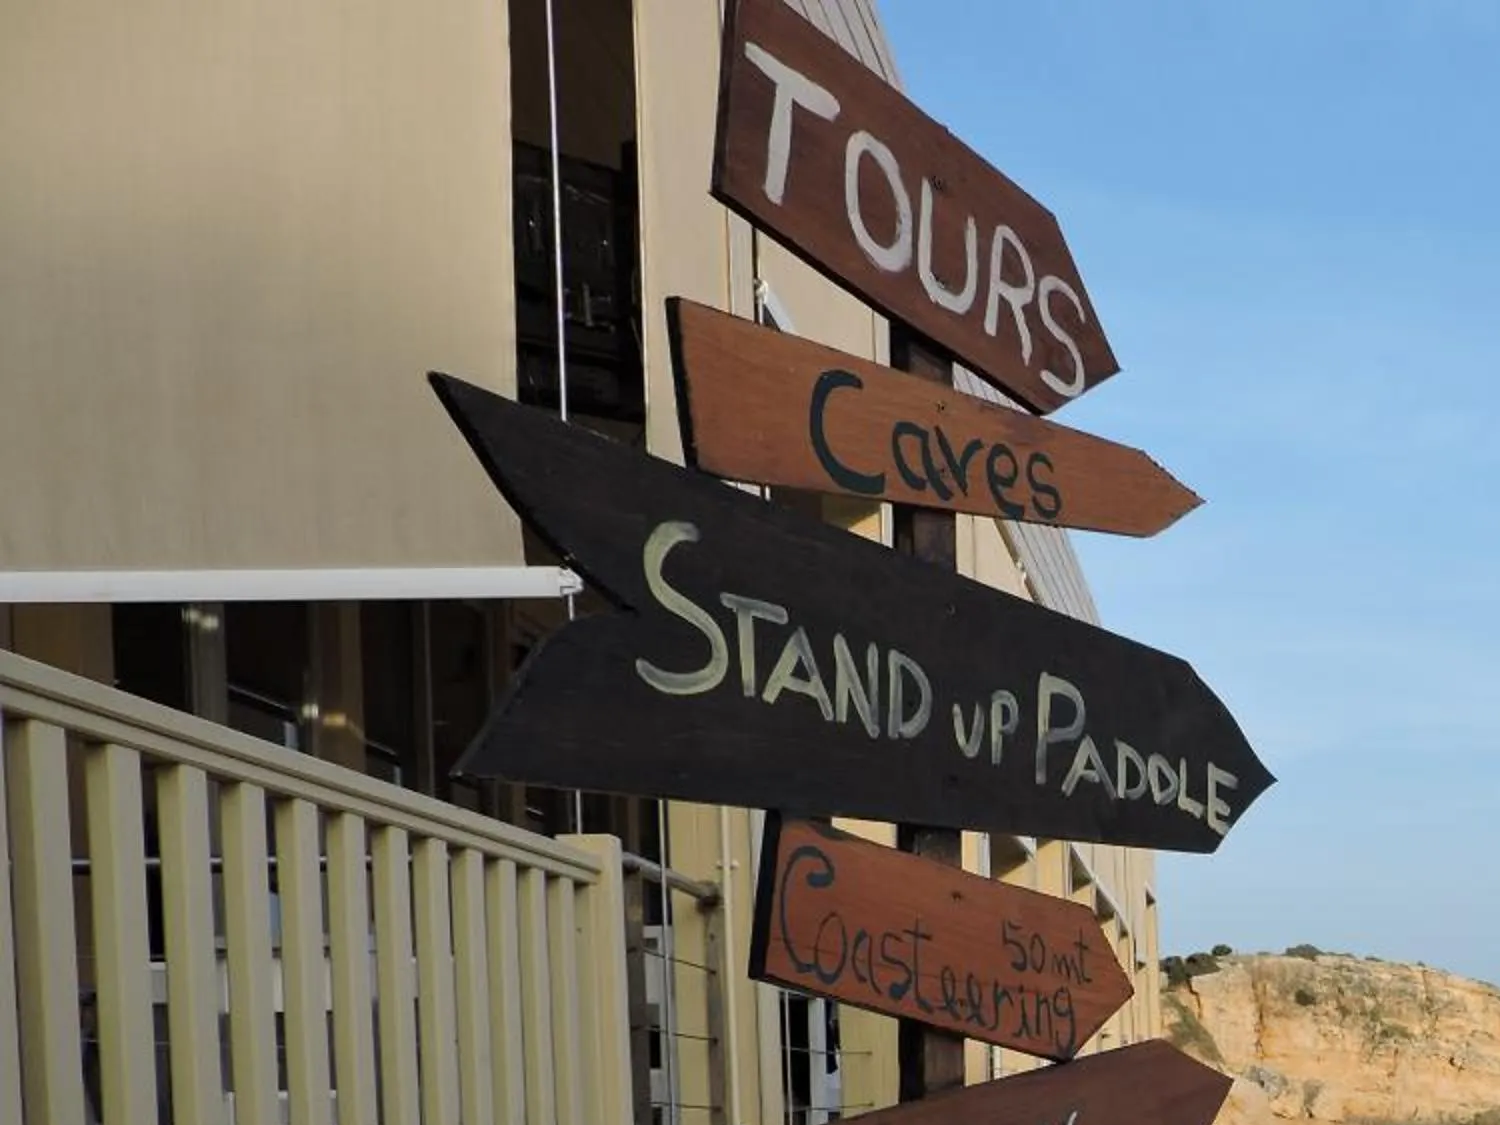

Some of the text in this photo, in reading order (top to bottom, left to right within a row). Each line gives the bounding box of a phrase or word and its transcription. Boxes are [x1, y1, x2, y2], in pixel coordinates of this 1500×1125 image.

[744, 41, 1086, 399] TOURS
[809, 370, 1063, 519] Caves
[635, 520, 932, 739] STAND
[1035, 671, 1239, 836] PADDLE
[779, 845, 1076, 1050] Coasteering
